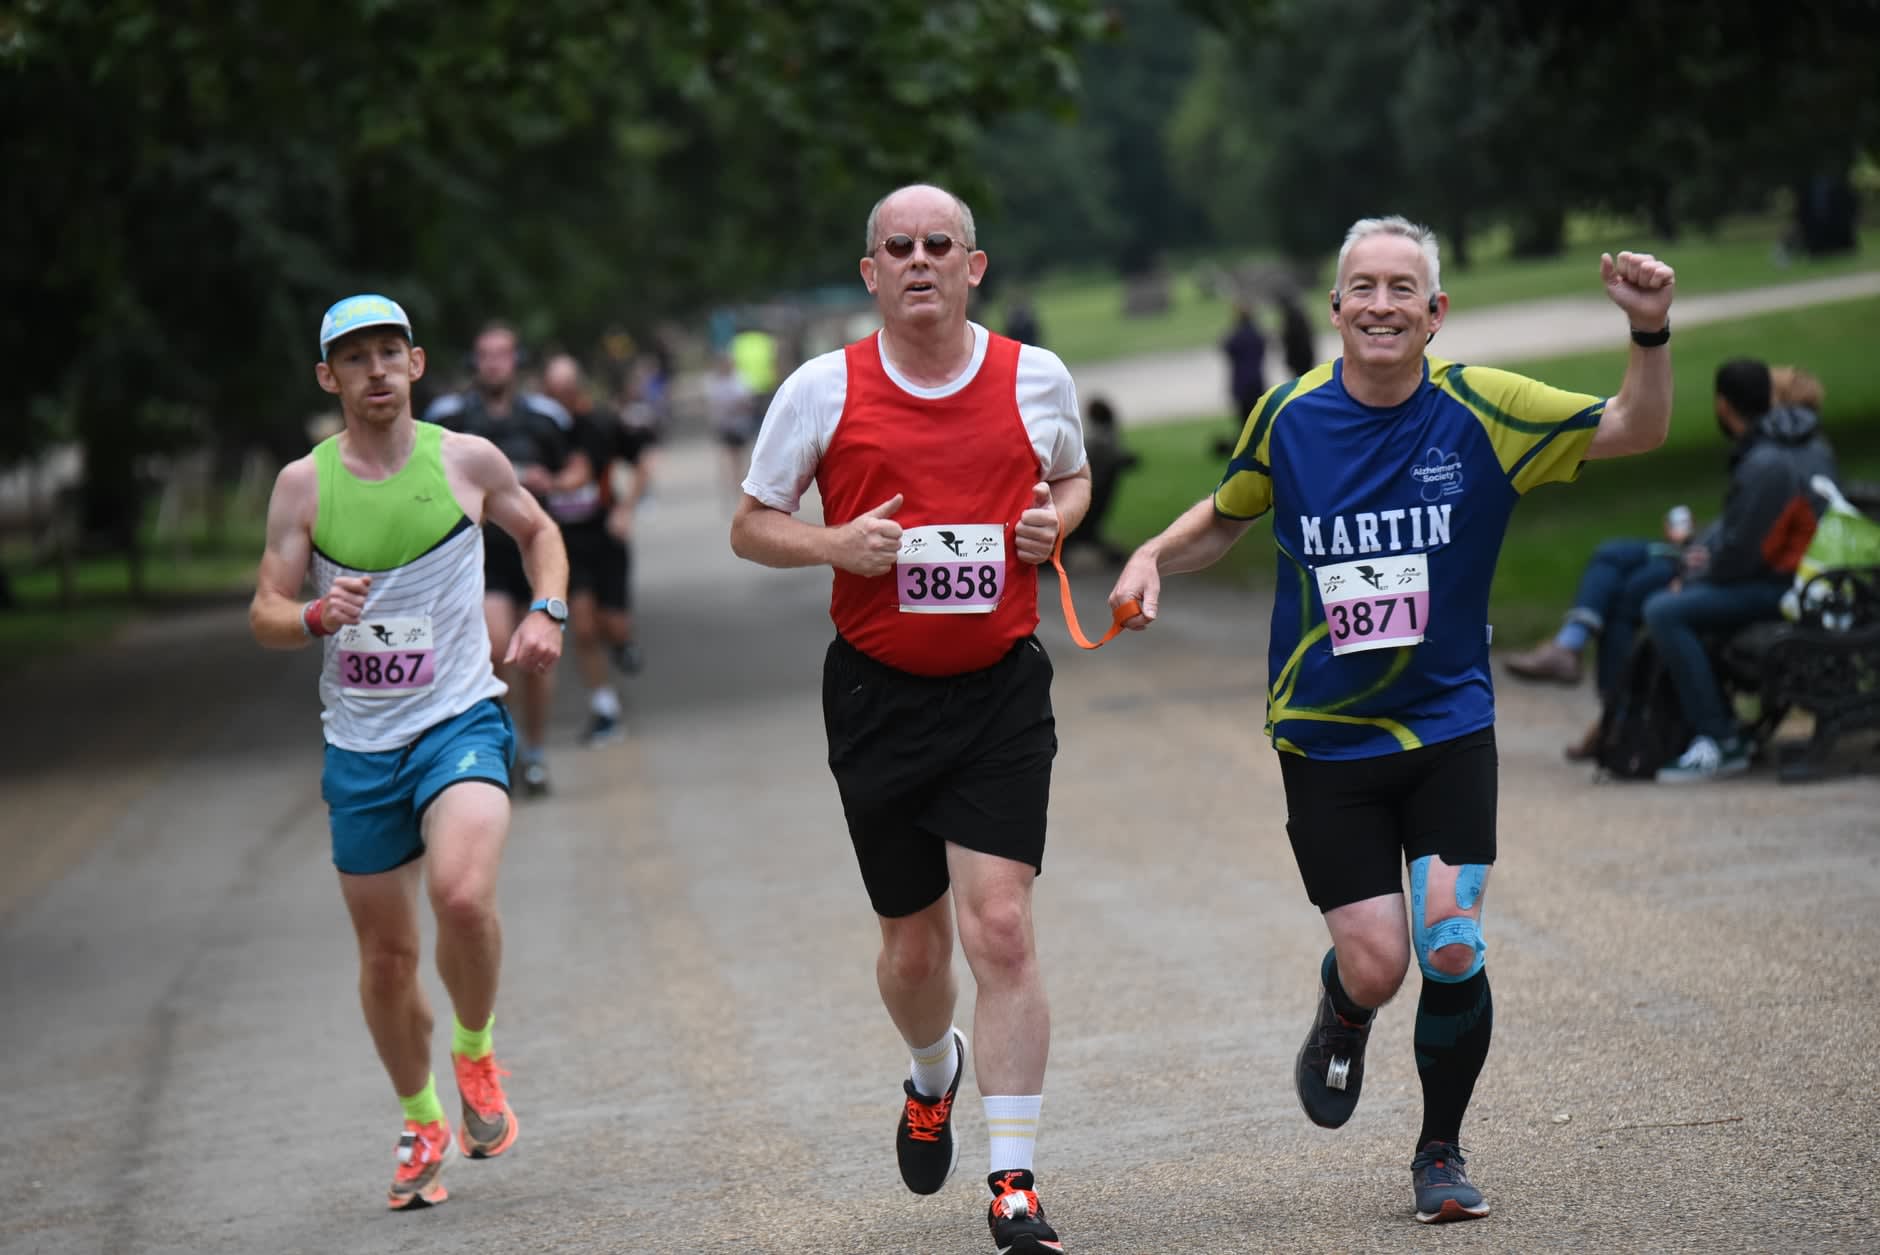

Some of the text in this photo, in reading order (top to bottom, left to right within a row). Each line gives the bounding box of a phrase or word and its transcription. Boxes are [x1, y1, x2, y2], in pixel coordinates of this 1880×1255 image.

[1423, 471, 1454, 483] Society
[1300, 504, 1452, 556] MARTIN
[906, 565, 998, 600] 3858
[1331, 596, 1418, 640] 3871
[346, 653, 426, 685] 3867
